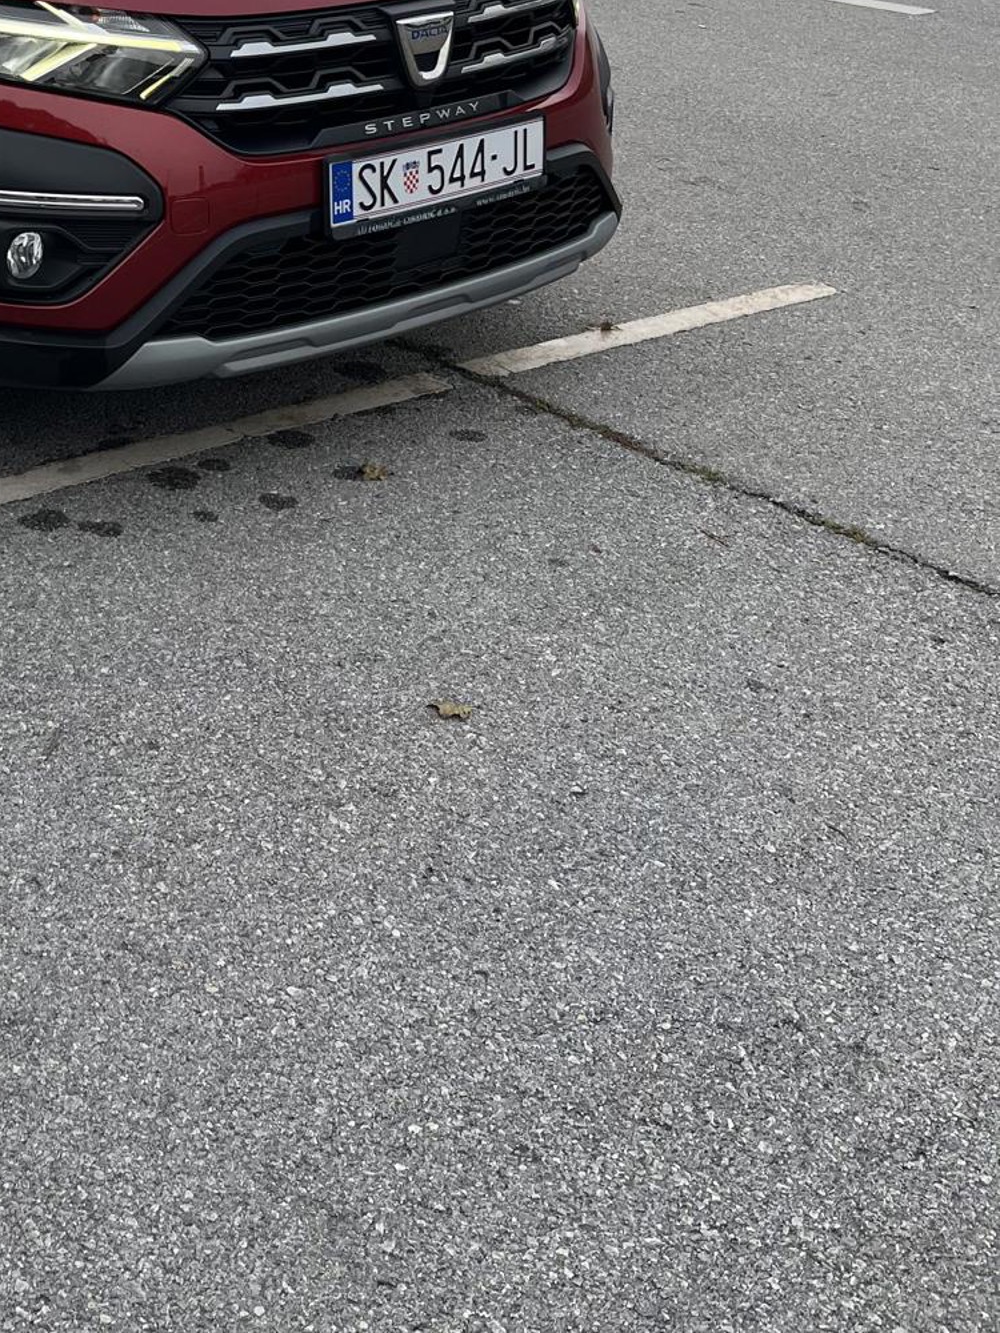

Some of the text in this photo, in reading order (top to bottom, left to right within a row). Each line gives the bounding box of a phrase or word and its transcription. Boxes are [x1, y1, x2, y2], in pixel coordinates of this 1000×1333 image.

[411, 27, 449, 40] DACIA
[364, 101, 479, 135] STEPWAY
[358, 128, 535, 211] SK 544-JL
[334, 199, 351, 215] HR
